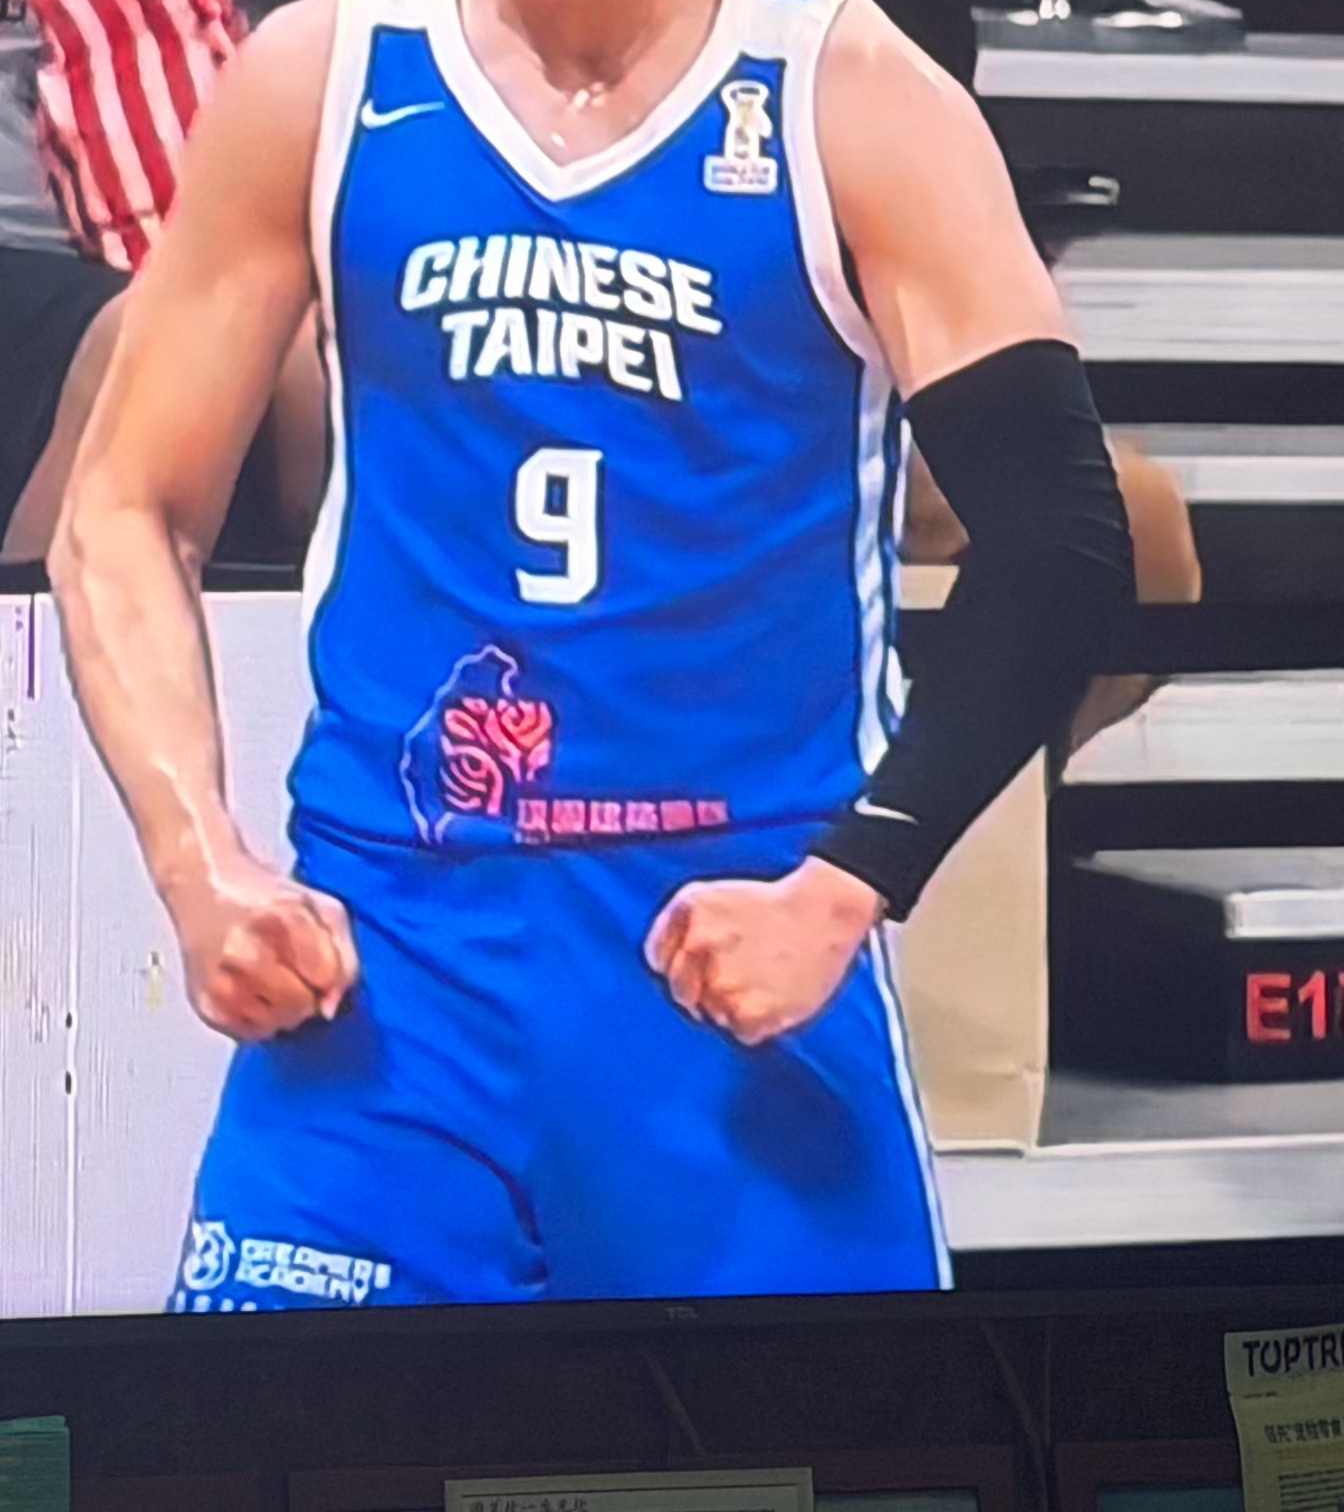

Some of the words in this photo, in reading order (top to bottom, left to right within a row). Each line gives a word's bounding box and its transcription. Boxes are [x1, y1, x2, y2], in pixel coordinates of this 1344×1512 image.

[400, 234, 723, 335] CHINESE
[441, 307, 684, 402] TAIPEI
[514, 447, 605, 604] 9
